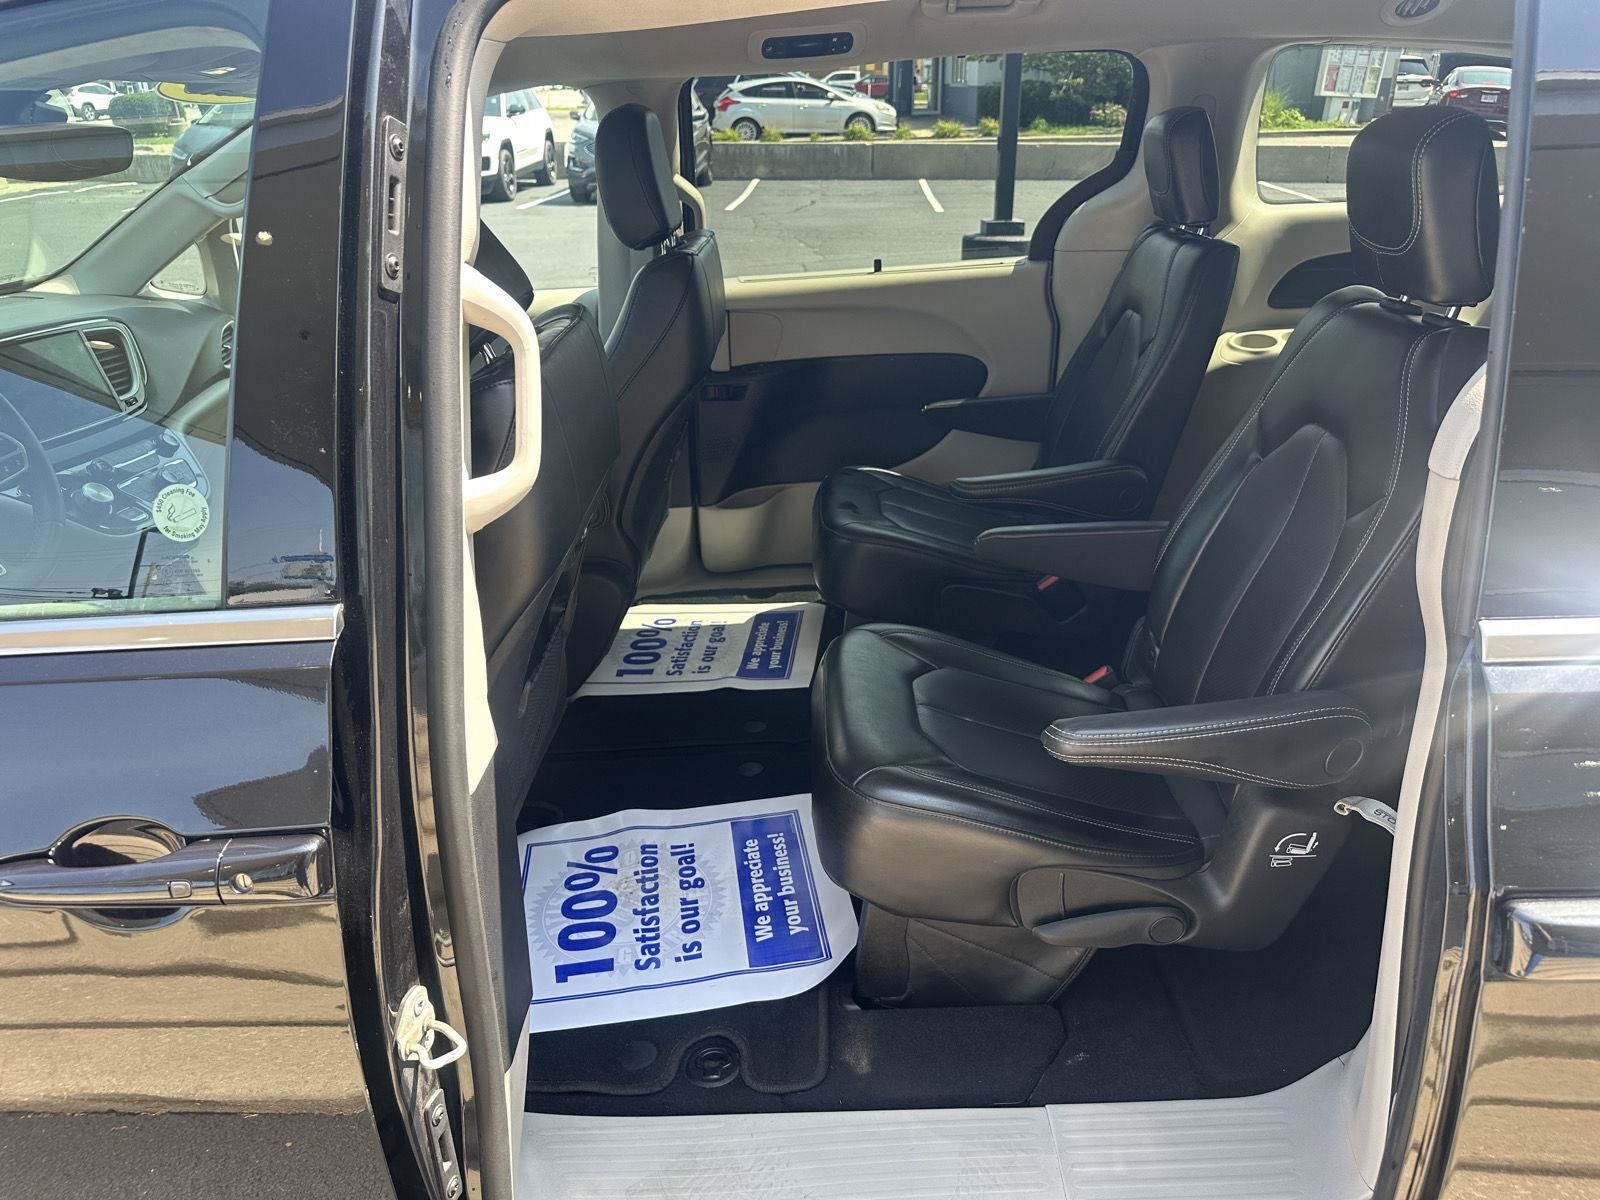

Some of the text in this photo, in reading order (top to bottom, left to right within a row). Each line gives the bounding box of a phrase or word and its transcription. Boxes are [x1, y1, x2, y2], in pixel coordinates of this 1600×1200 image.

[162, 488, 185, 499] Cleaning
[186, 489, 195, 498] Fee
[171, 531, 196, 539] Smoking
[194, 523, 206, 533] May
[615, 618, 677, 678] 100%
[666, 620, 702, 676] Satisfaction
[692, 620, 728, 675] is our goal!
[746, 621, 770, 670] We appreciate
[768, 619, 788, 669] your business!
[633, 843, 661, 971] Satisfaction
[670, 842, 706, 963] is our goal!
[742, 838, 774, 943] We appreciate
[767, 832, 808, 935] your business!
[555, 845, 620, 984] 100%
